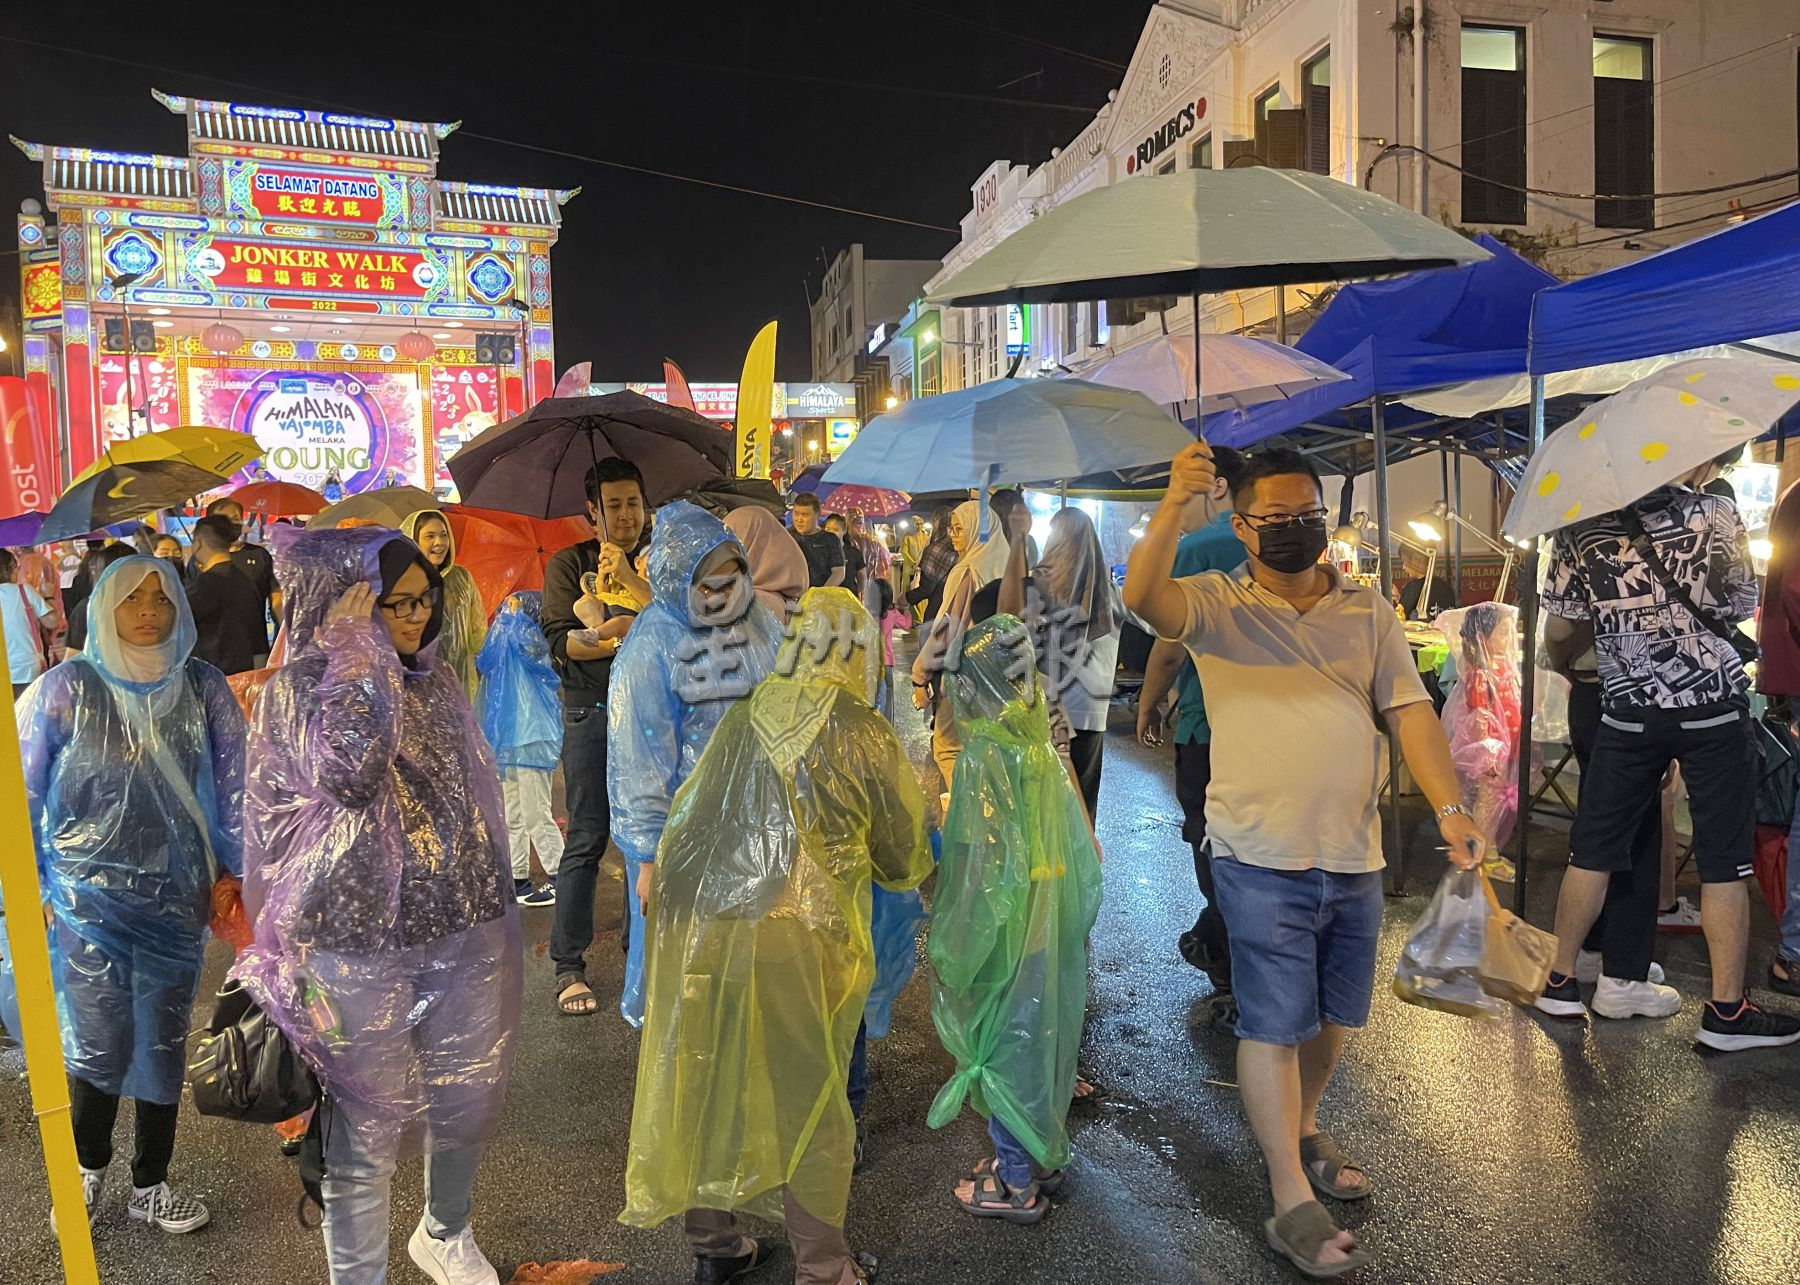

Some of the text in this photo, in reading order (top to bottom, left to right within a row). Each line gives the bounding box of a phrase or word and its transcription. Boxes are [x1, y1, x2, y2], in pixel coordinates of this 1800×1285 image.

[256, 174, 378, 198] SELAMAT DATANG
[976, 174, 997, 218] 1930
[230, 245, 408, 273] JONKER WALK
[311, 301, 337, 310] 2022
[800, 395, 844, 407] HIMALAYA
[808, 406, 836, 416] Sports
[259, 446, 371, 471] YOUNG
[11, 463, 41, 513] ost
[1462, 568, 1501, 577] MELAKA
